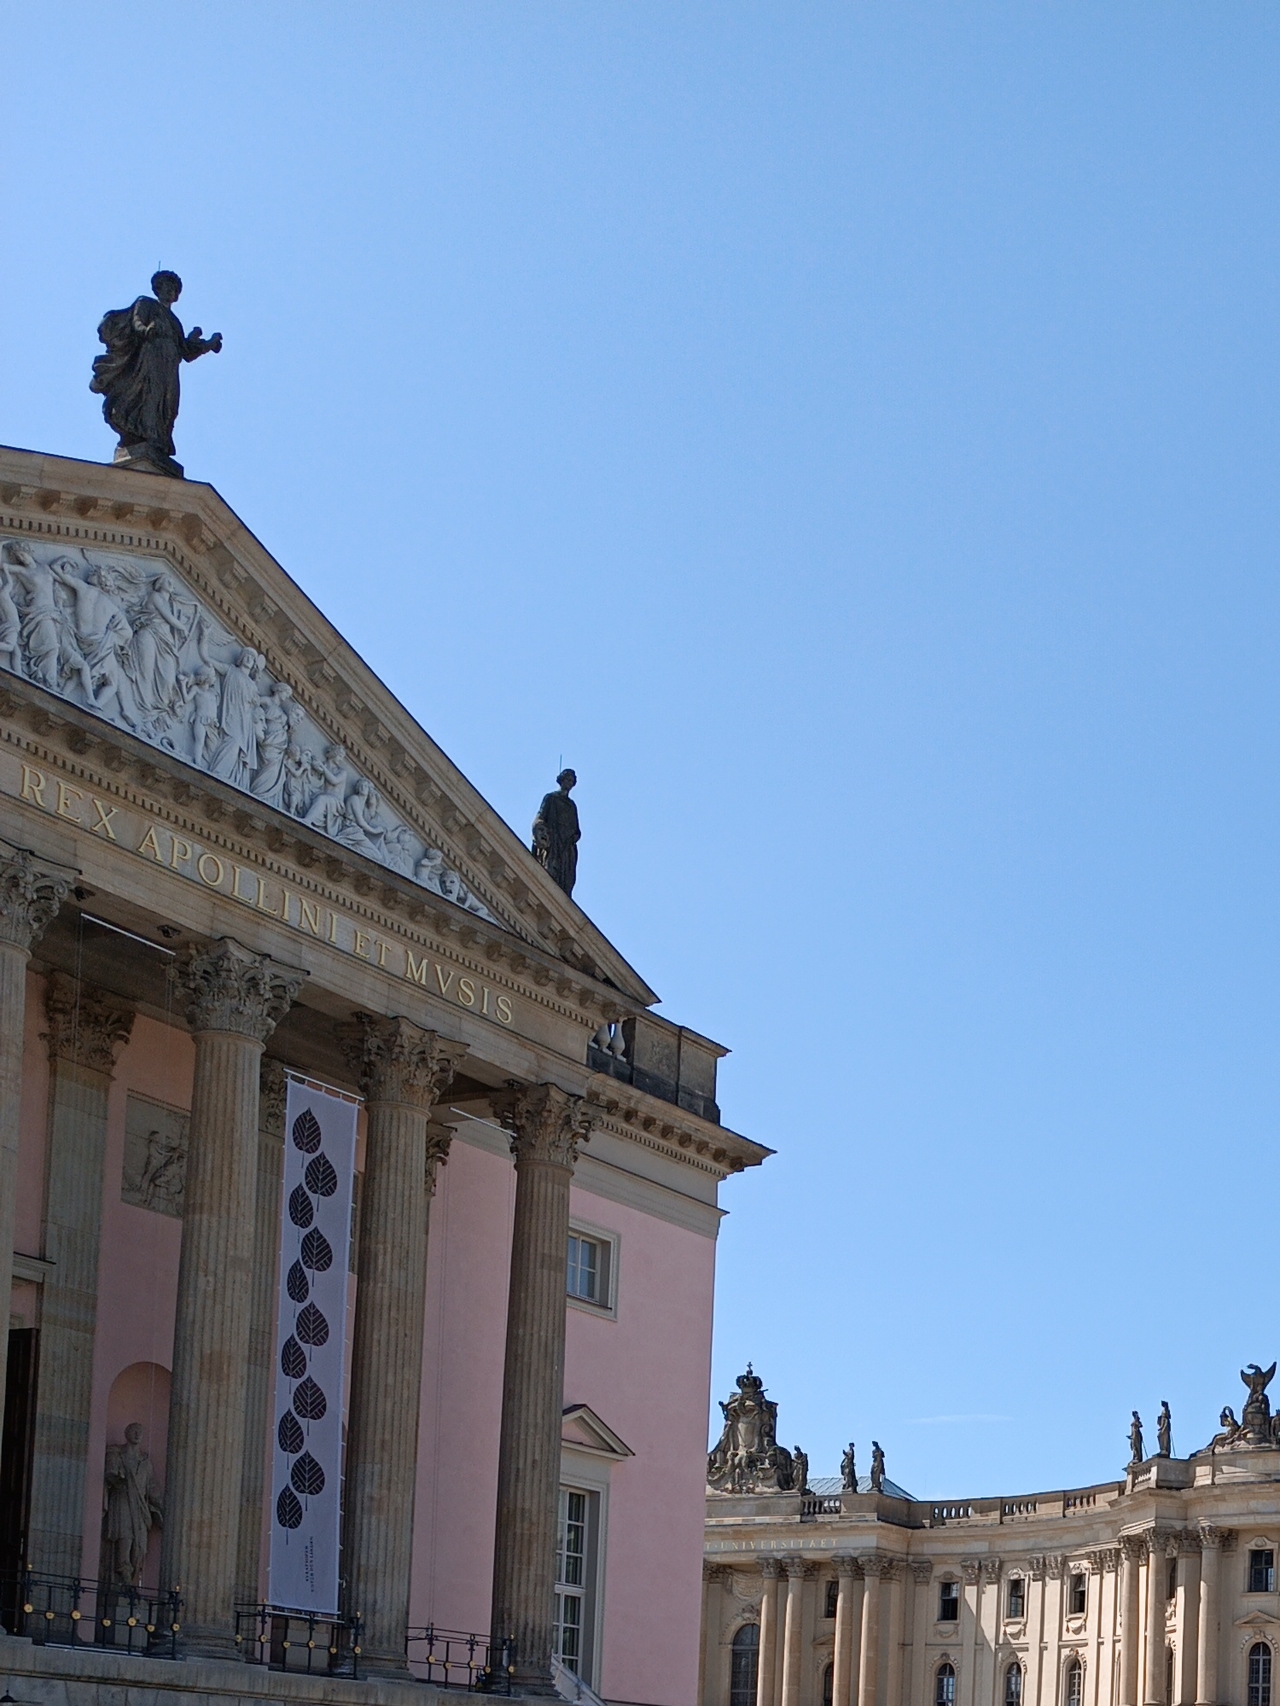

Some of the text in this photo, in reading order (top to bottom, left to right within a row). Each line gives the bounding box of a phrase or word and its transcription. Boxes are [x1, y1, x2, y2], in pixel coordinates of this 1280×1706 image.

[20, 764, 513, 1024] REX APOLLINI ET MVSIS
